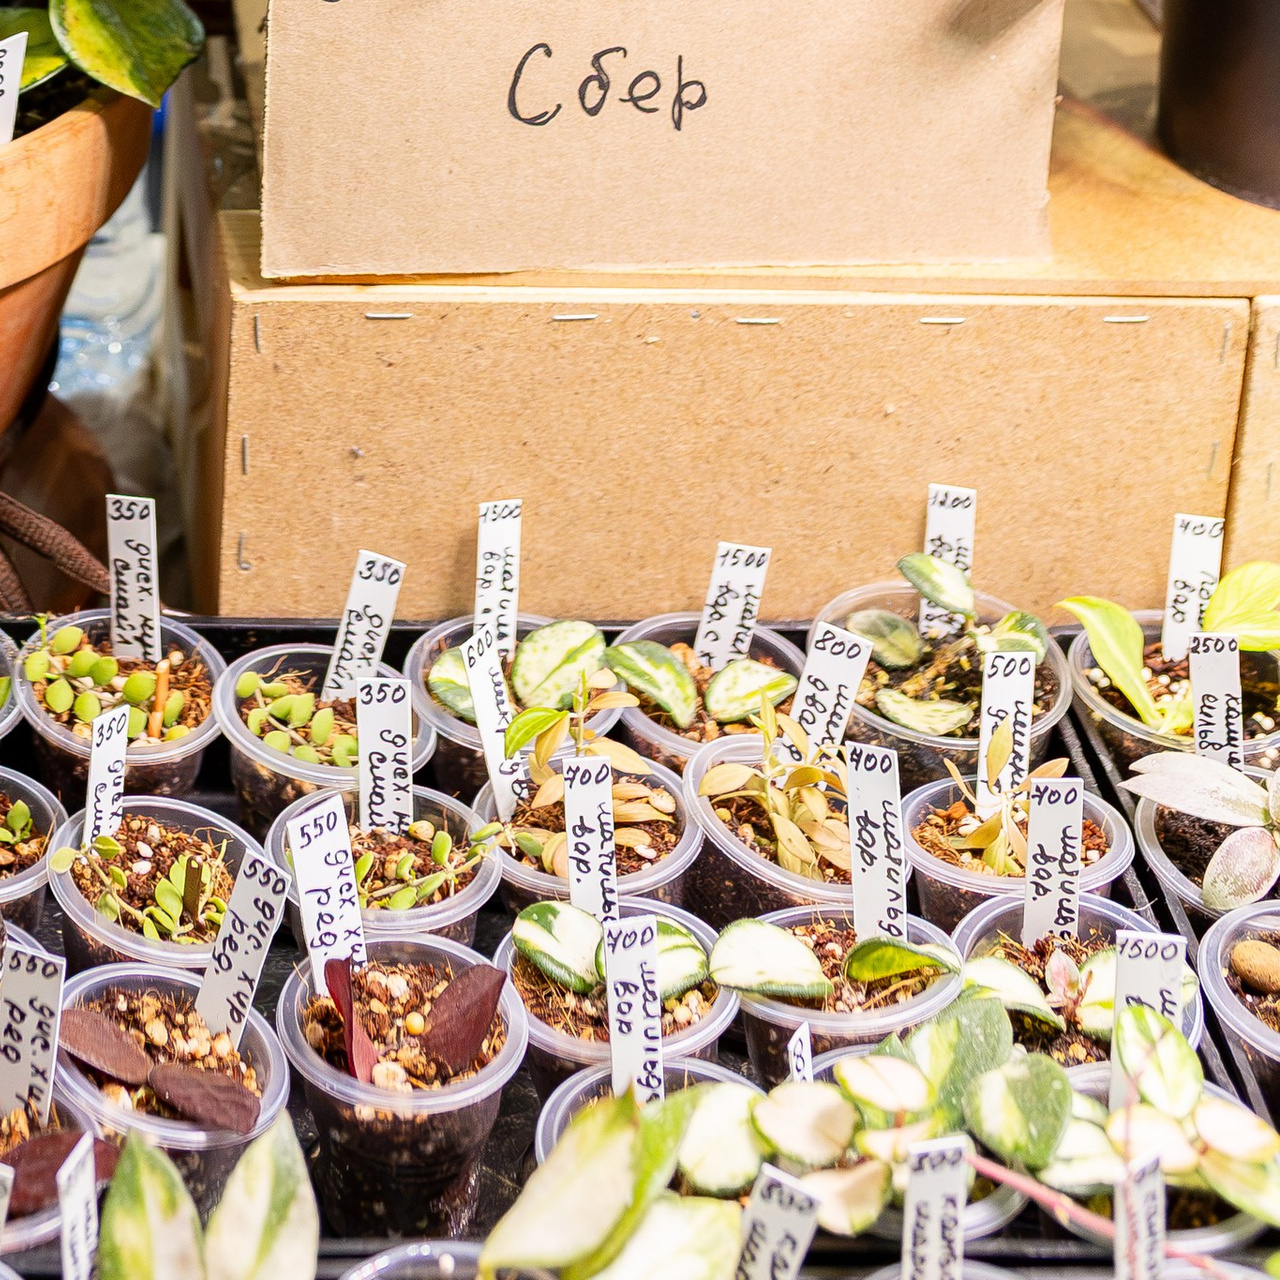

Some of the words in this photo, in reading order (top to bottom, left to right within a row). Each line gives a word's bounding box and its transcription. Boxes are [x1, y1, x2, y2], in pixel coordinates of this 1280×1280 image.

[506, 42, 708, 133] Сбер
[110, 499, 151, 521] 350
[478, 504, 522, 523] 1500
[720, 548, 766, 568] 1500
[359, 560, 400, 585] 350
[467, 630, 493, 669] 600
[814, 630, 861, 659] 800
[1190, 636, 1238, 654] 2500
[987, 655, 1030, 679] 500
[360, 683, 407, 705] 350
[96, 713, 127, 747] 350
[299, 810, 337, 849] 550
[243, 859, 286, 895] 550
[1119, 938, 1178, 961] 1500
[9, 950, 59, 978] 550
